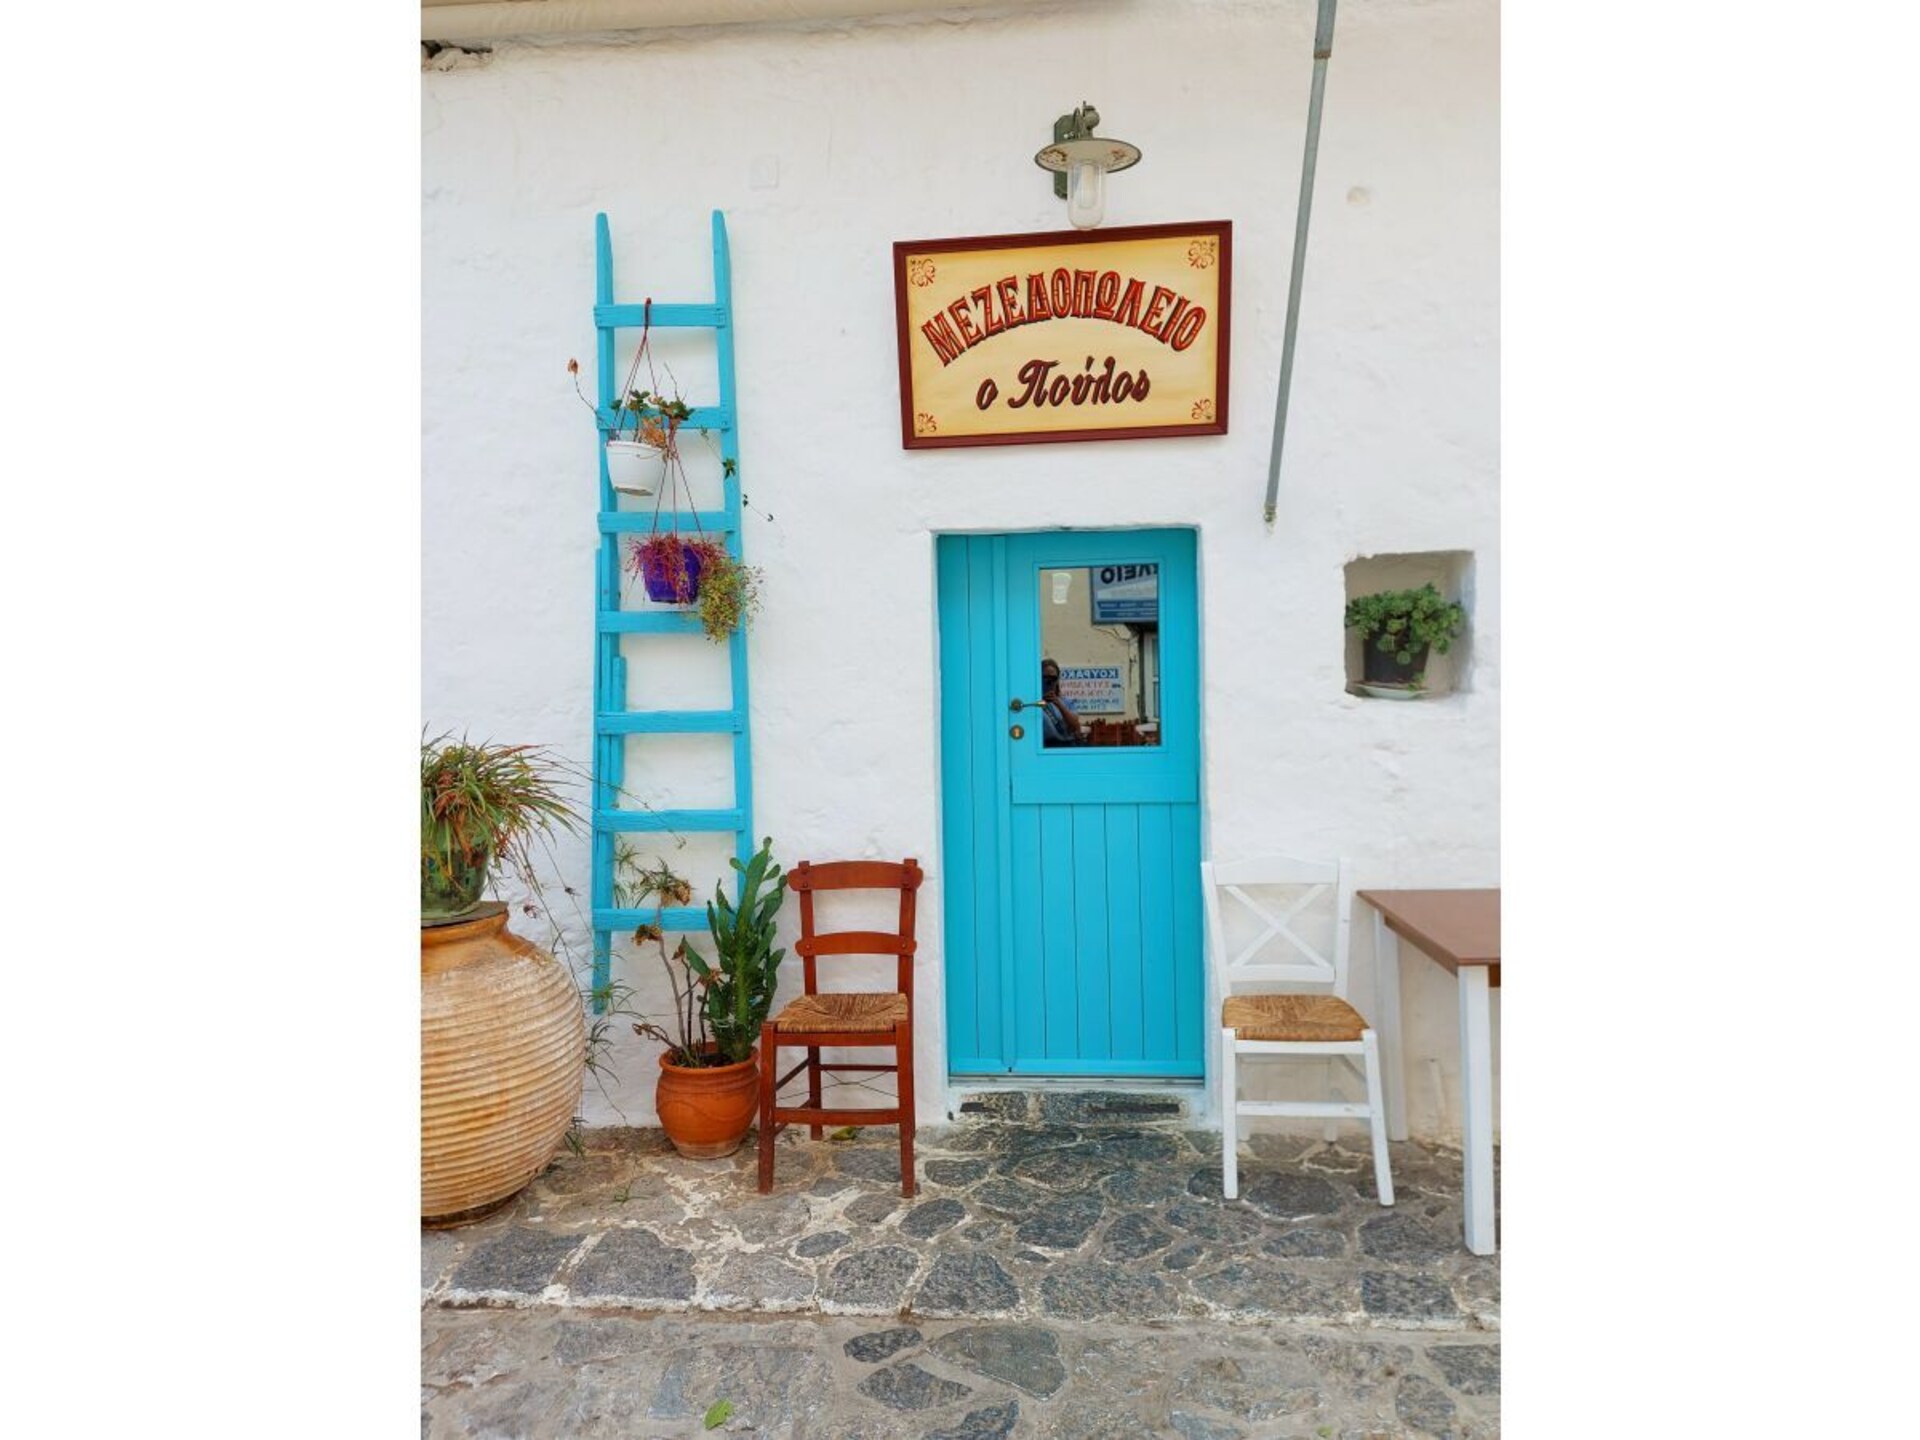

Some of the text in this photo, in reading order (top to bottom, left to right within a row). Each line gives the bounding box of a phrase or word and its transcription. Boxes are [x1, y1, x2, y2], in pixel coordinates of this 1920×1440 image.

[921, 267, 1207, 367] ΜΕΖΕΔΟΠΩΛΕΙΟ
[976, 356, 1151, 410] ο Πούλος
